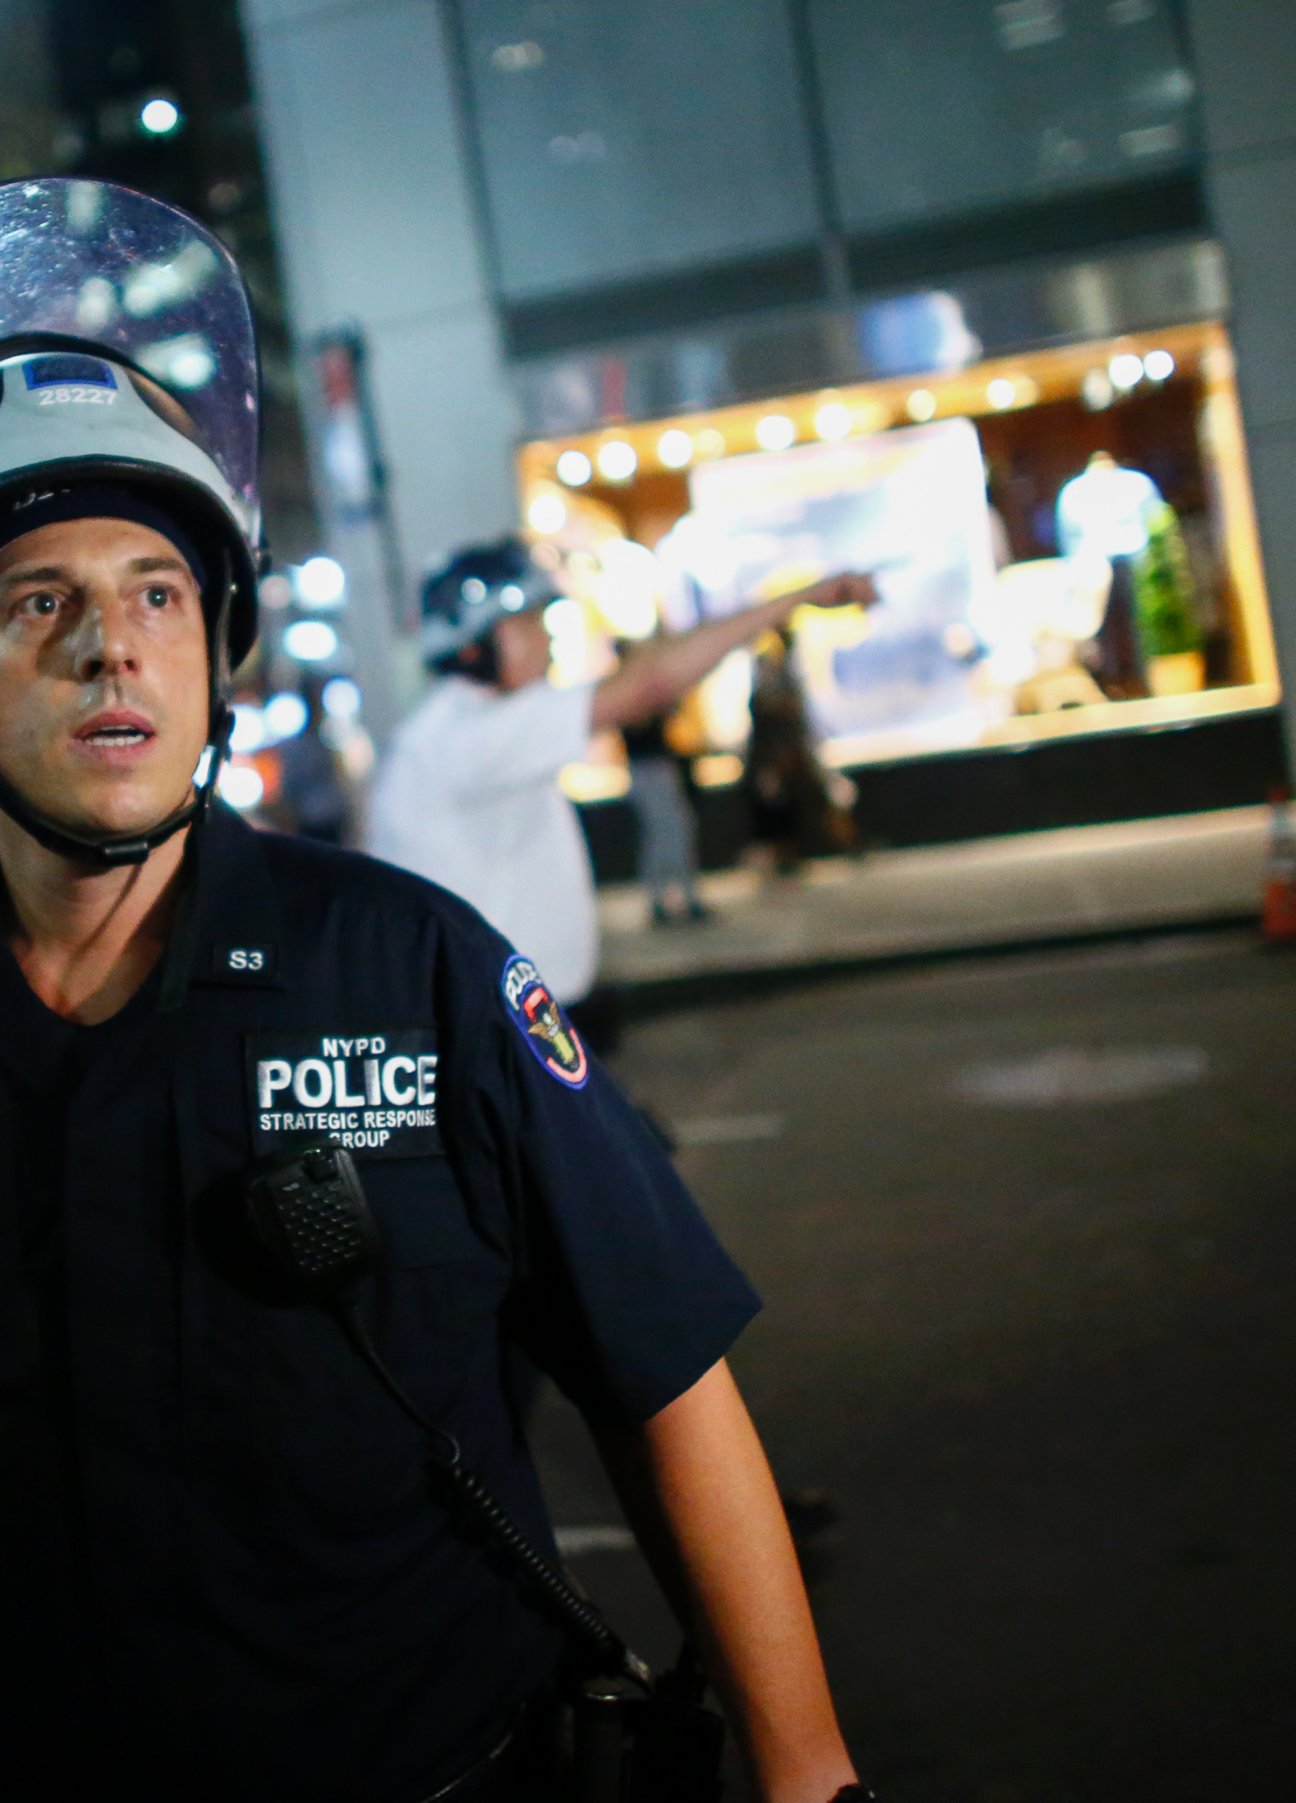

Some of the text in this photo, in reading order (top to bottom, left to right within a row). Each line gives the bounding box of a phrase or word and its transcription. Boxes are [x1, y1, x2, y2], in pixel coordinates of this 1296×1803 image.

[38, 387, 118, 406] 28227
[229, 949, 264, 971] S3
[322, 1036, 386, 1058] NYPD
[257, 1056, 438, 1109] POLICE
[259, 1108, 436, 1131] STRATEGIC RESPONSE
